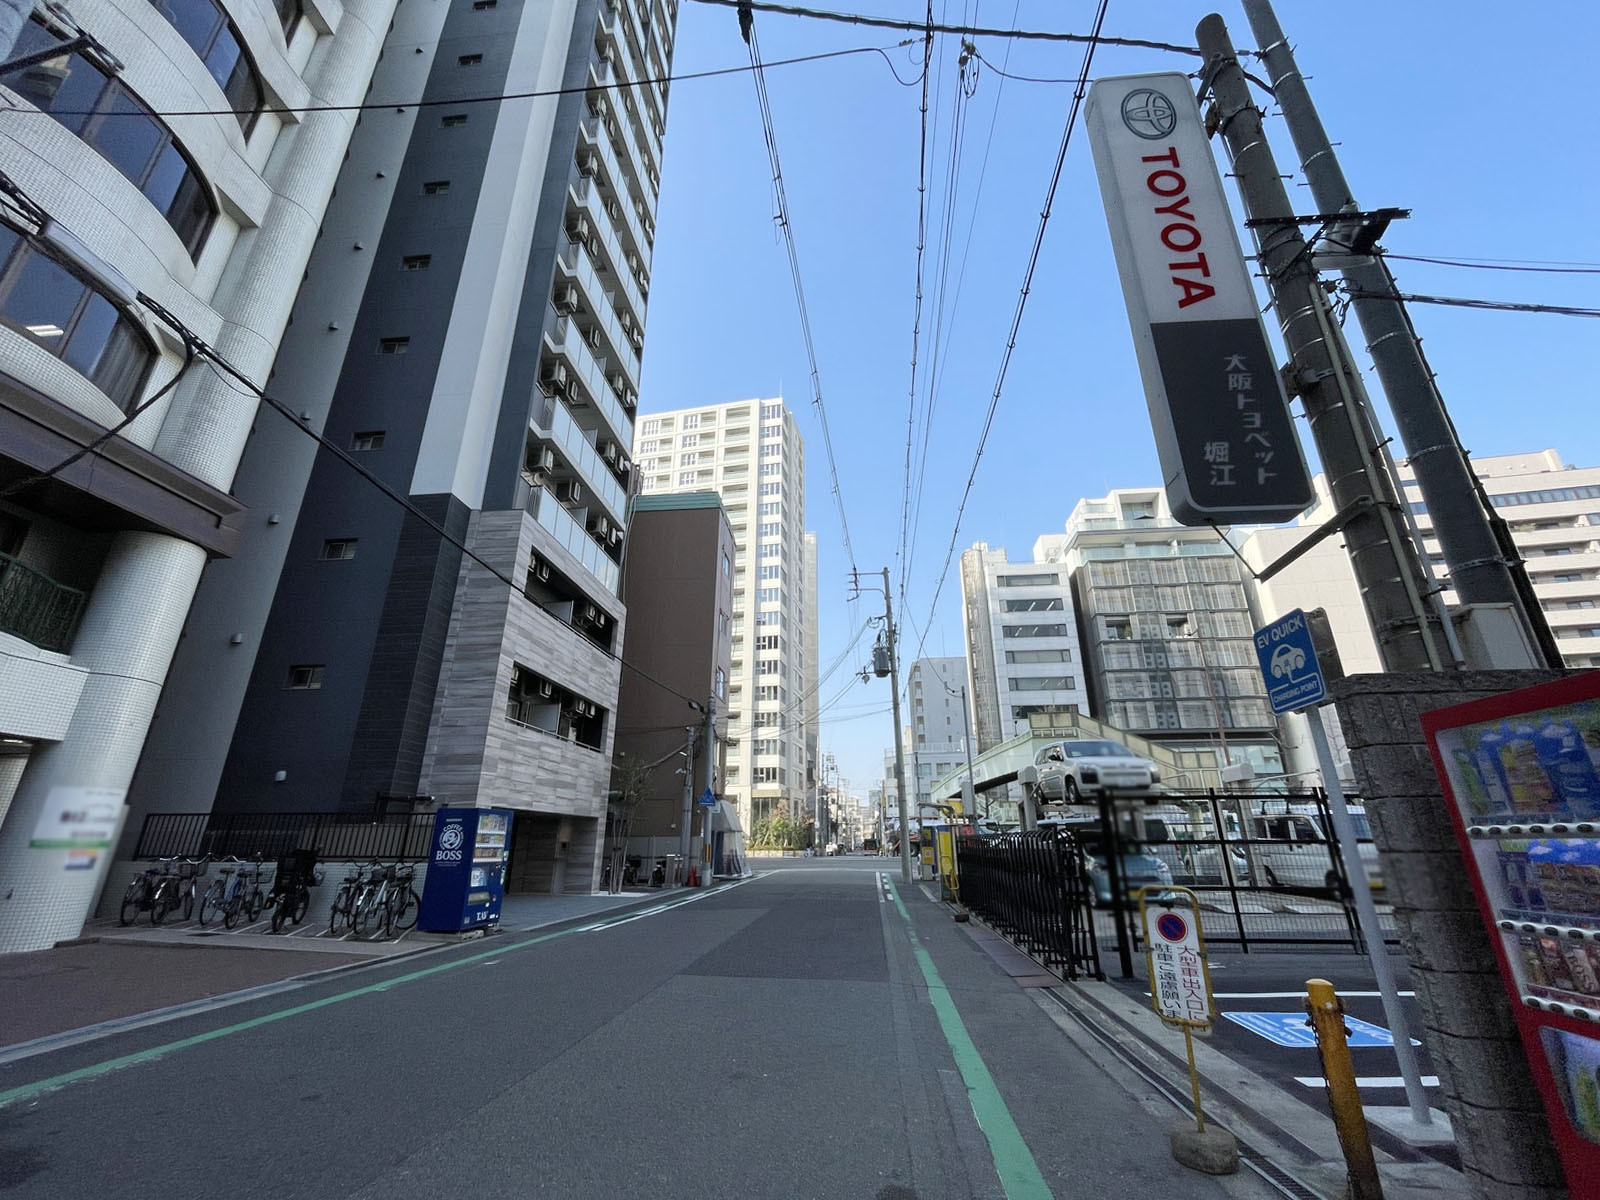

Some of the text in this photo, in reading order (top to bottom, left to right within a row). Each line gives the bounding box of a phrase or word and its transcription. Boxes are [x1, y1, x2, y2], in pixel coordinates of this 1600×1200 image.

[1141, 146, 1216, 309] TOYOTA
[1203, 441, 1236, 486] 堀江
[1257, 615, 1303, 649] EV QUICK
[435, 850, 463, 861] BOSS
[1154, 943, 1181, 1026] 駐車ご遠慮願いま
[1177, 944, 1208, 1032] 大型車出入口に
